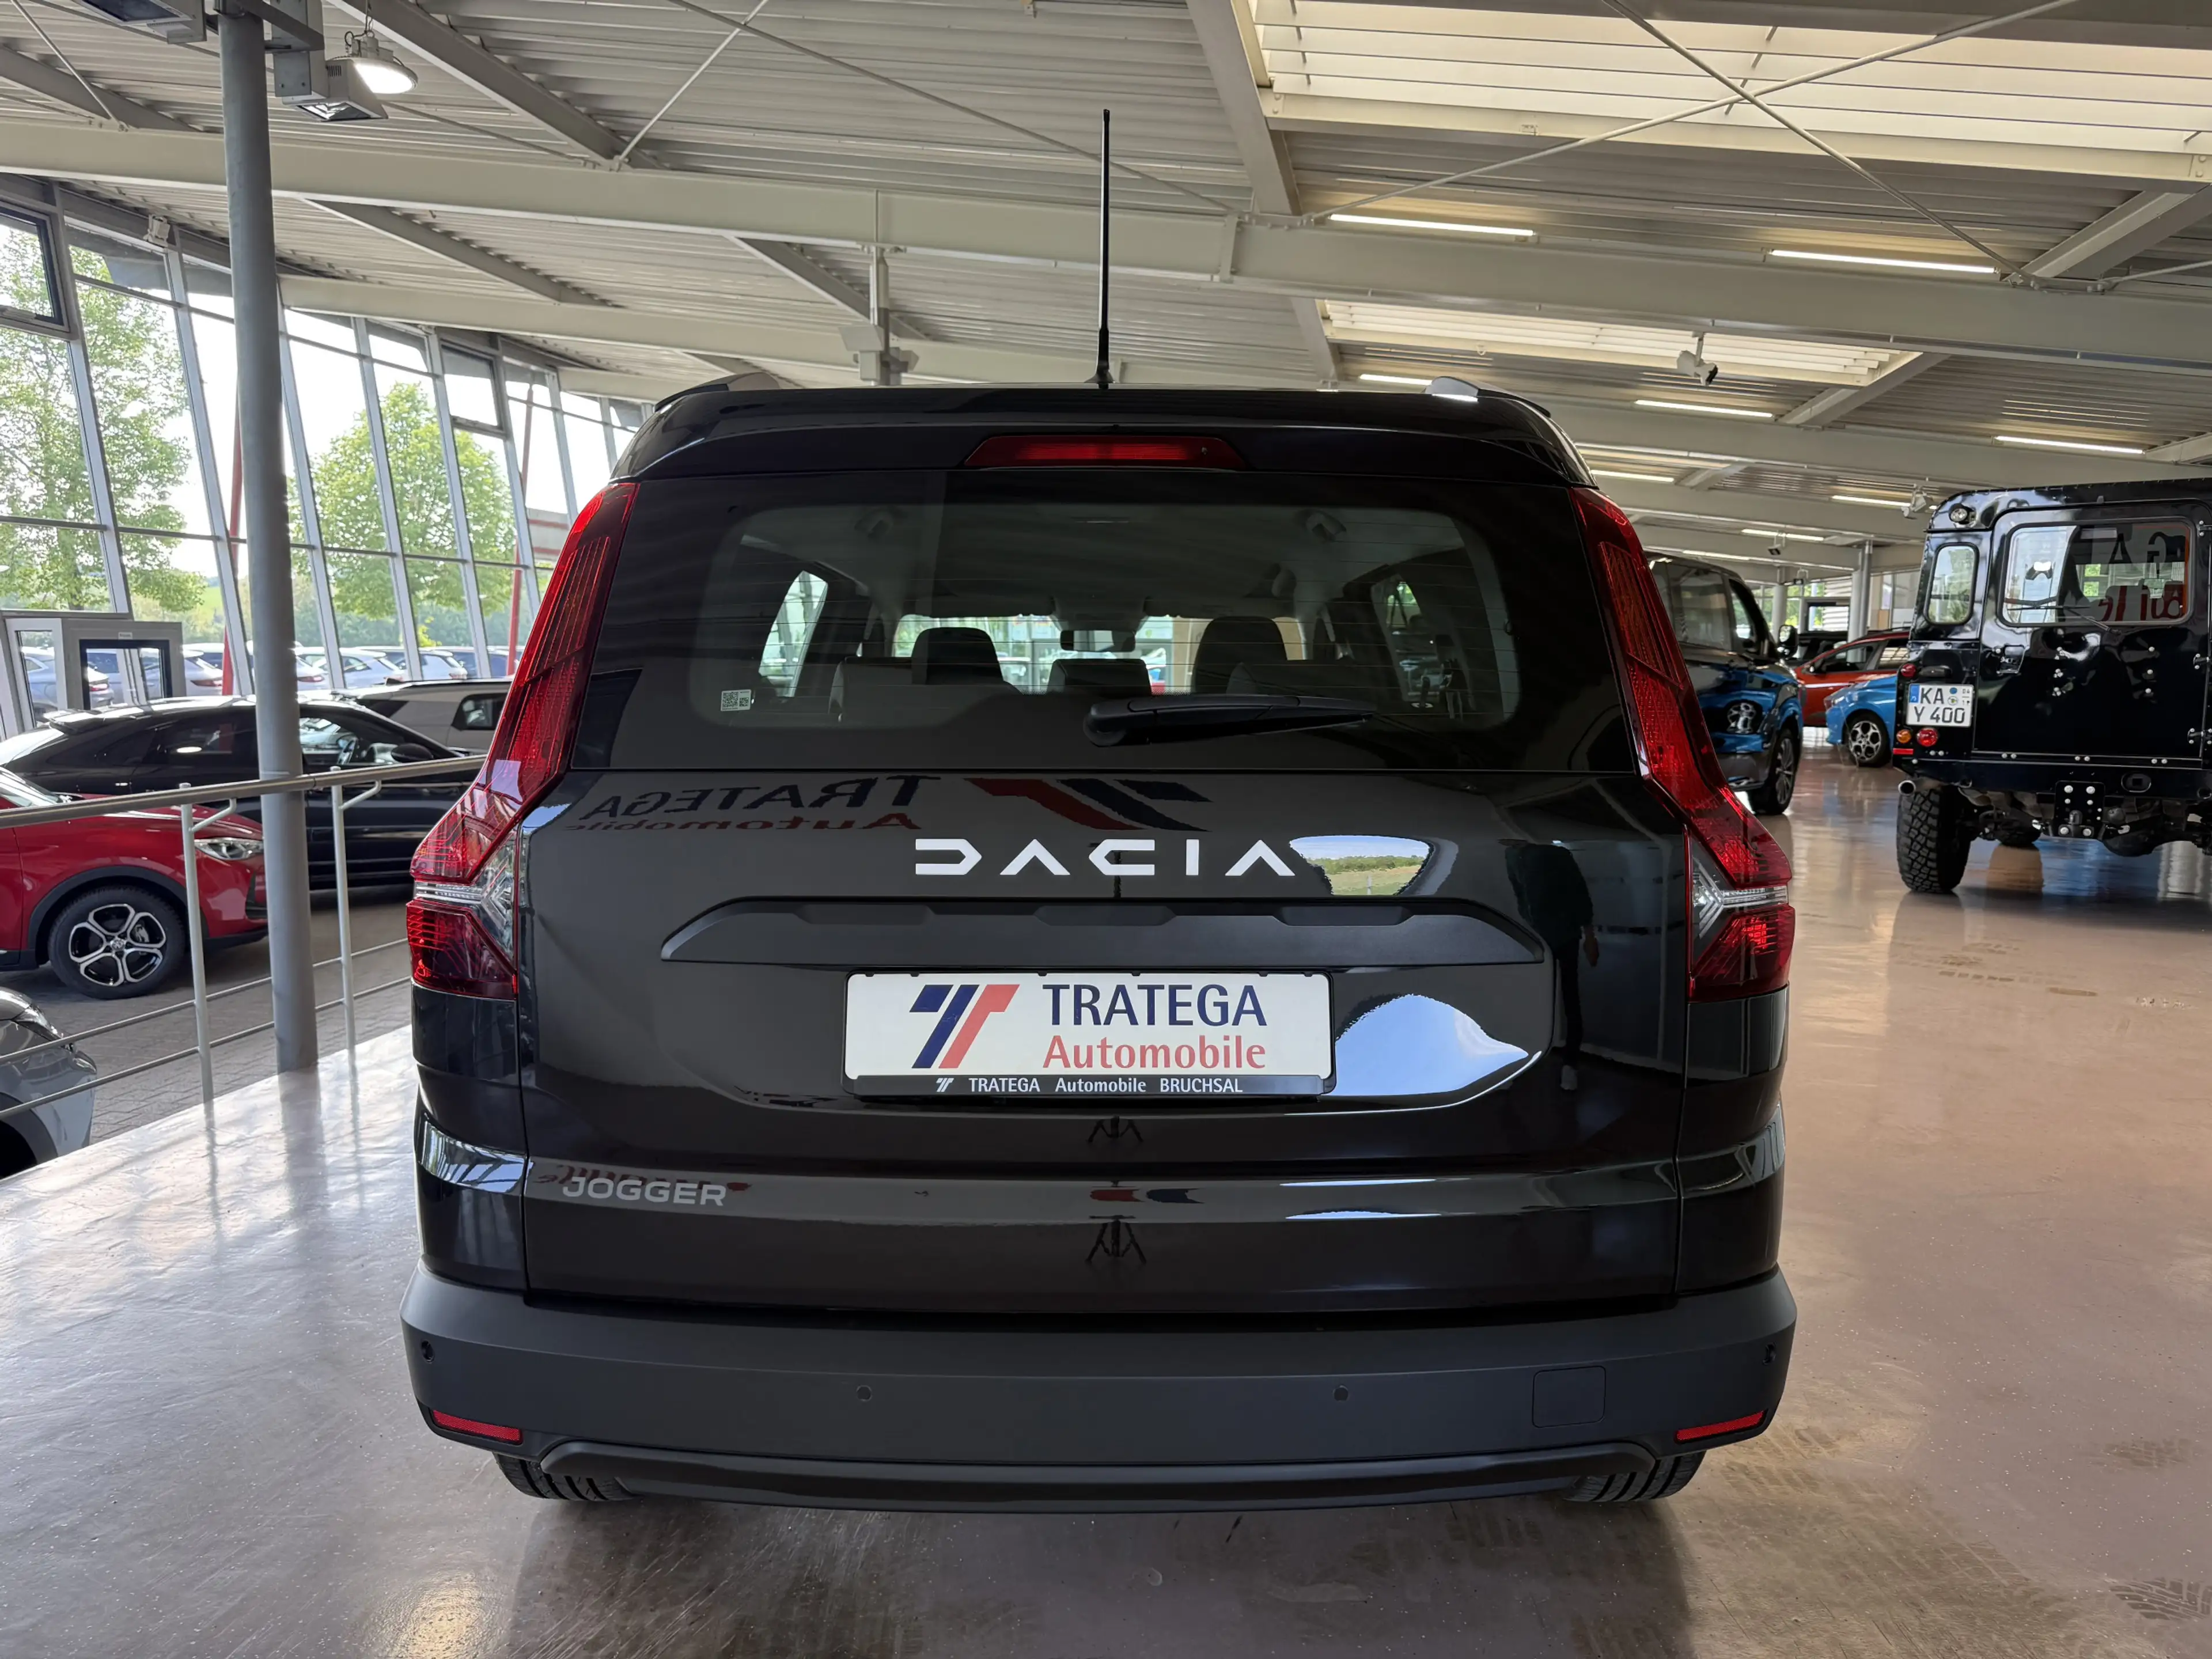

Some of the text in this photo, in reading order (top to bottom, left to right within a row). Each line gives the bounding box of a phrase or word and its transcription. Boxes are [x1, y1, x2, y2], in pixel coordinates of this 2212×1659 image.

[1920, 687, 1944, 704] KA
[1914, 706, 1965, 724] Y 400
[915, 838, 1296, 876] DACIA
[1042, 984, 1267, 1027] TRATEGA
[1042, 1035, 1266, 1069] Automobile
[969, 1078, 1243, 1093] TRATEGA Automobile BRUCHSAL
[563, 1176, 726, 1206] JOGGER
